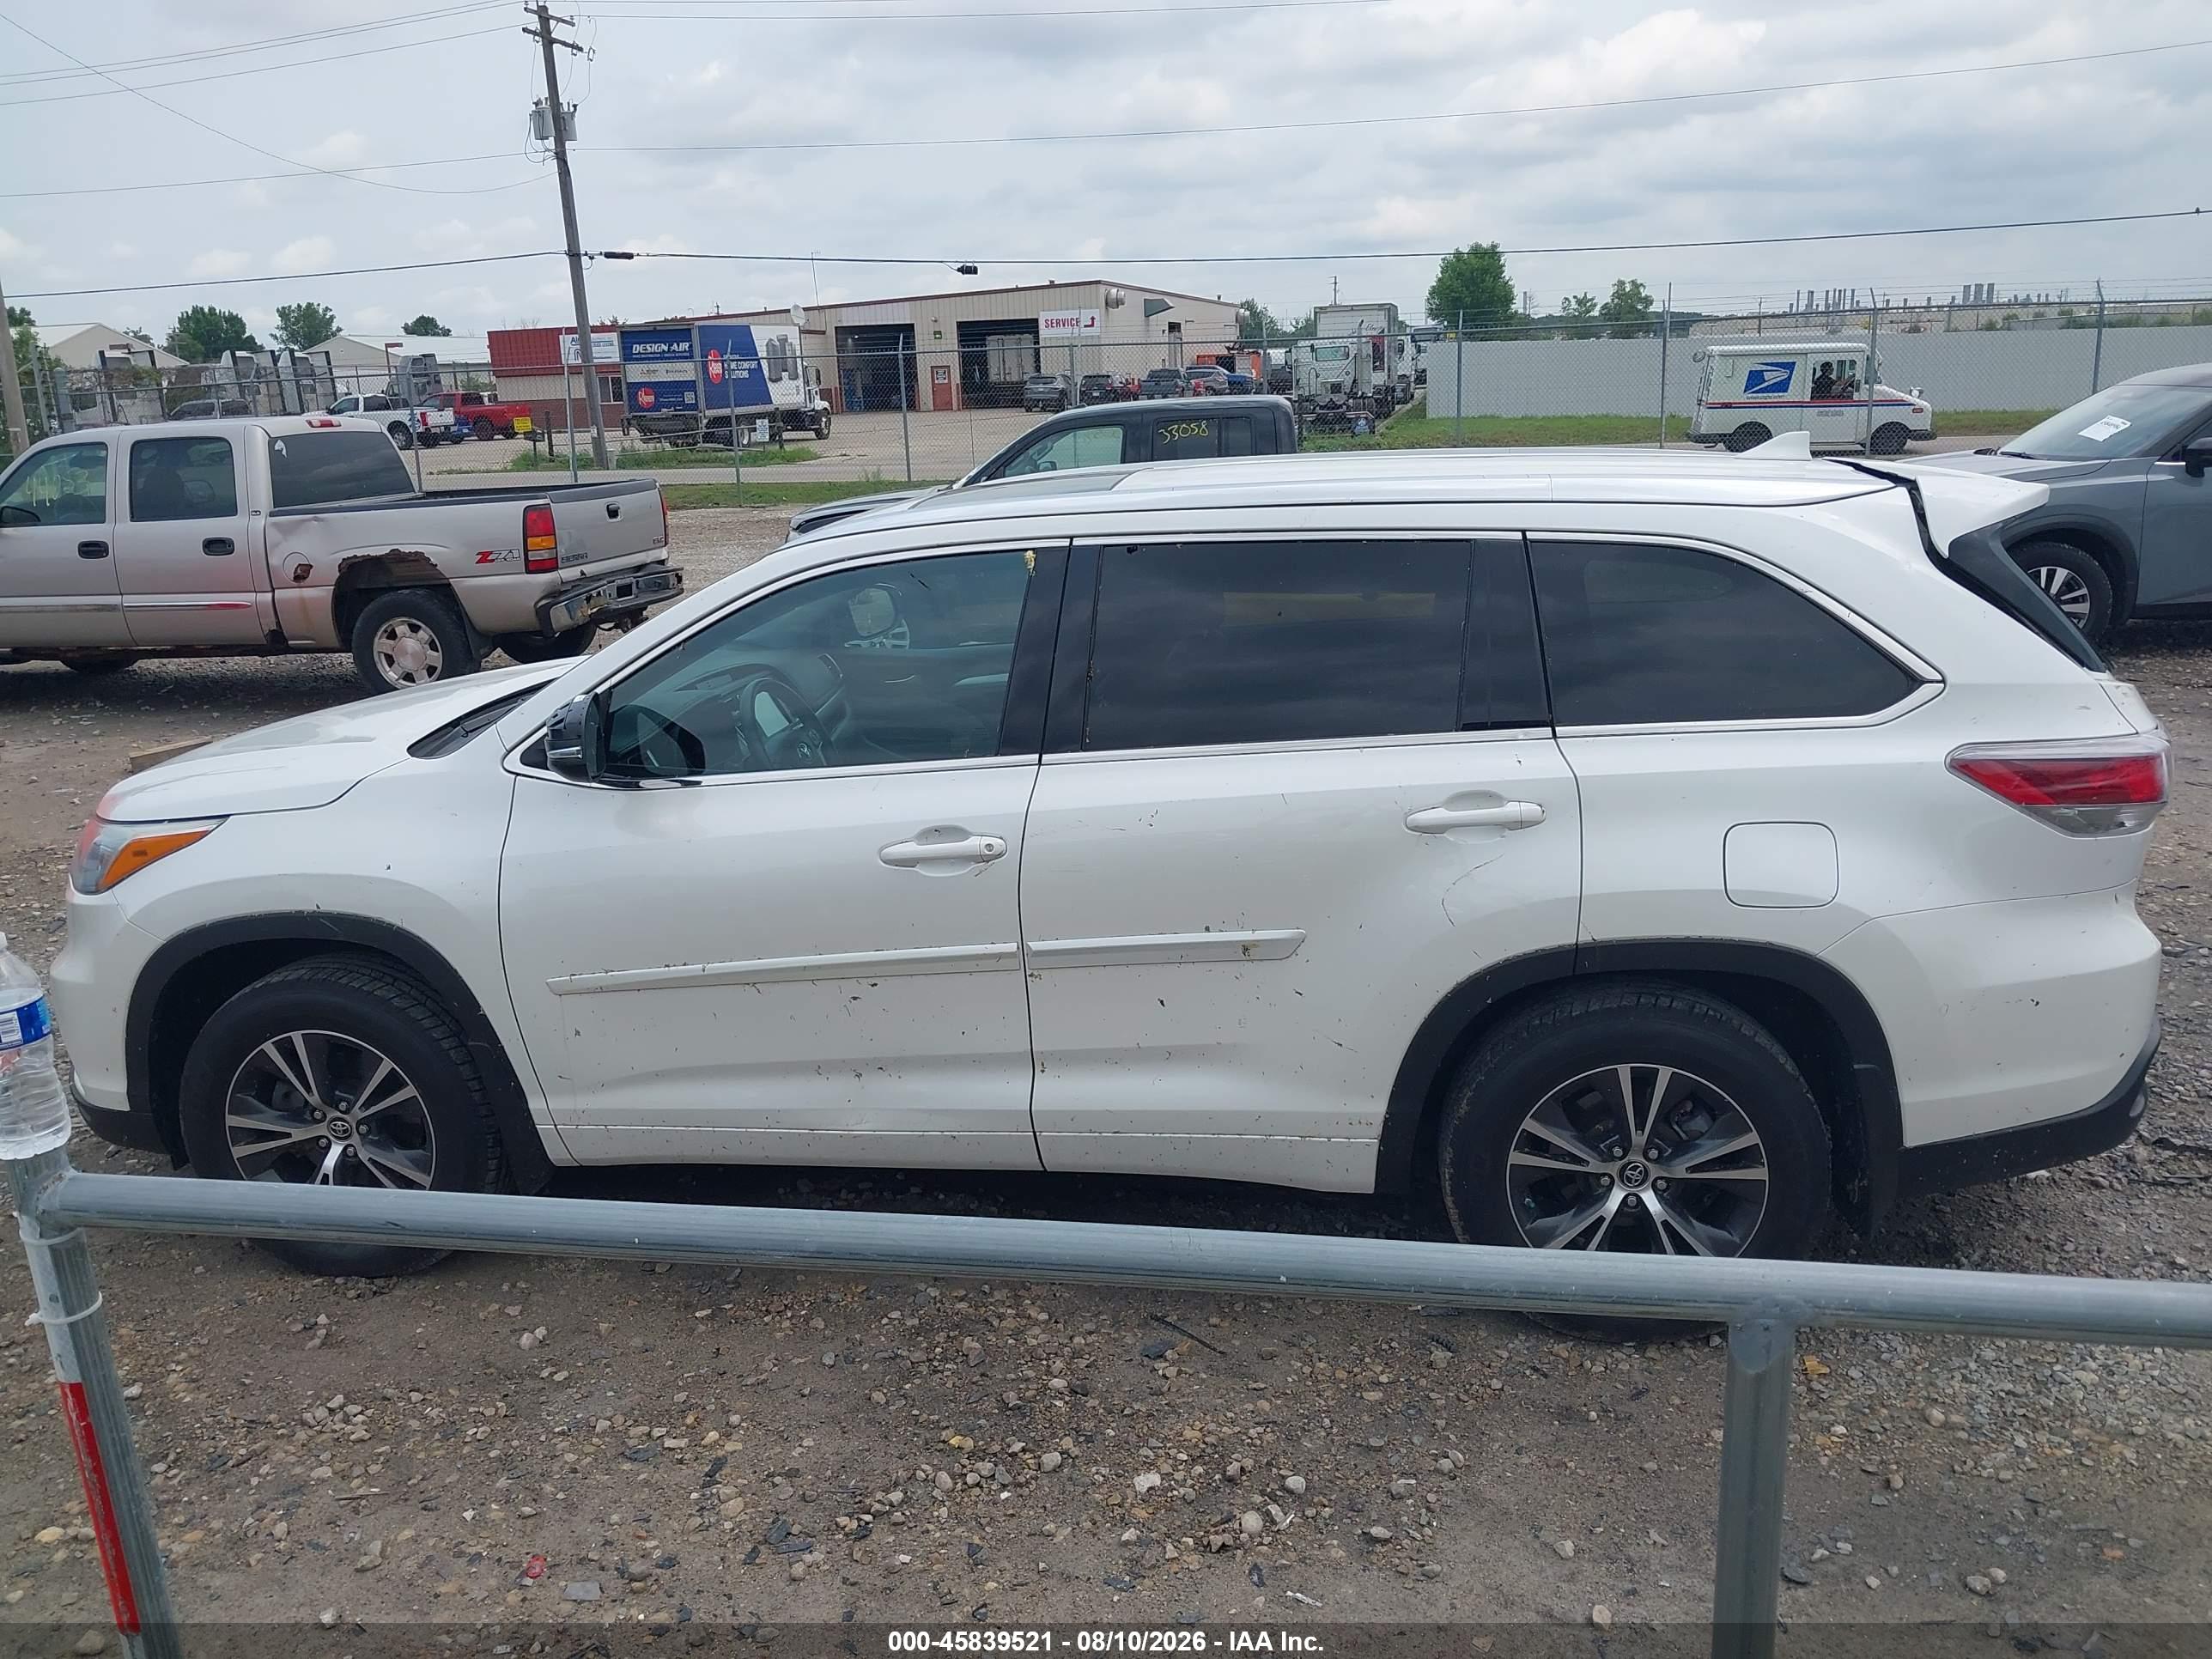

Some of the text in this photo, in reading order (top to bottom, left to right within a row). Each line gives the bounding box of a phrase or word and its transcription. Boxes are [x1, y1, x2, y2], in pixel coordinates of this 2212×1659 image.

[1044, 318, 1080, 329] SERVICE
[632, 342, 690, 354] DESIGN AIR
[724, 361, 738, 370] HME
[724, 369, 750, 380] SLUTIONS
[1158, 420, 1209, 445] 33058
[475, 548, 521, 564] Z71
